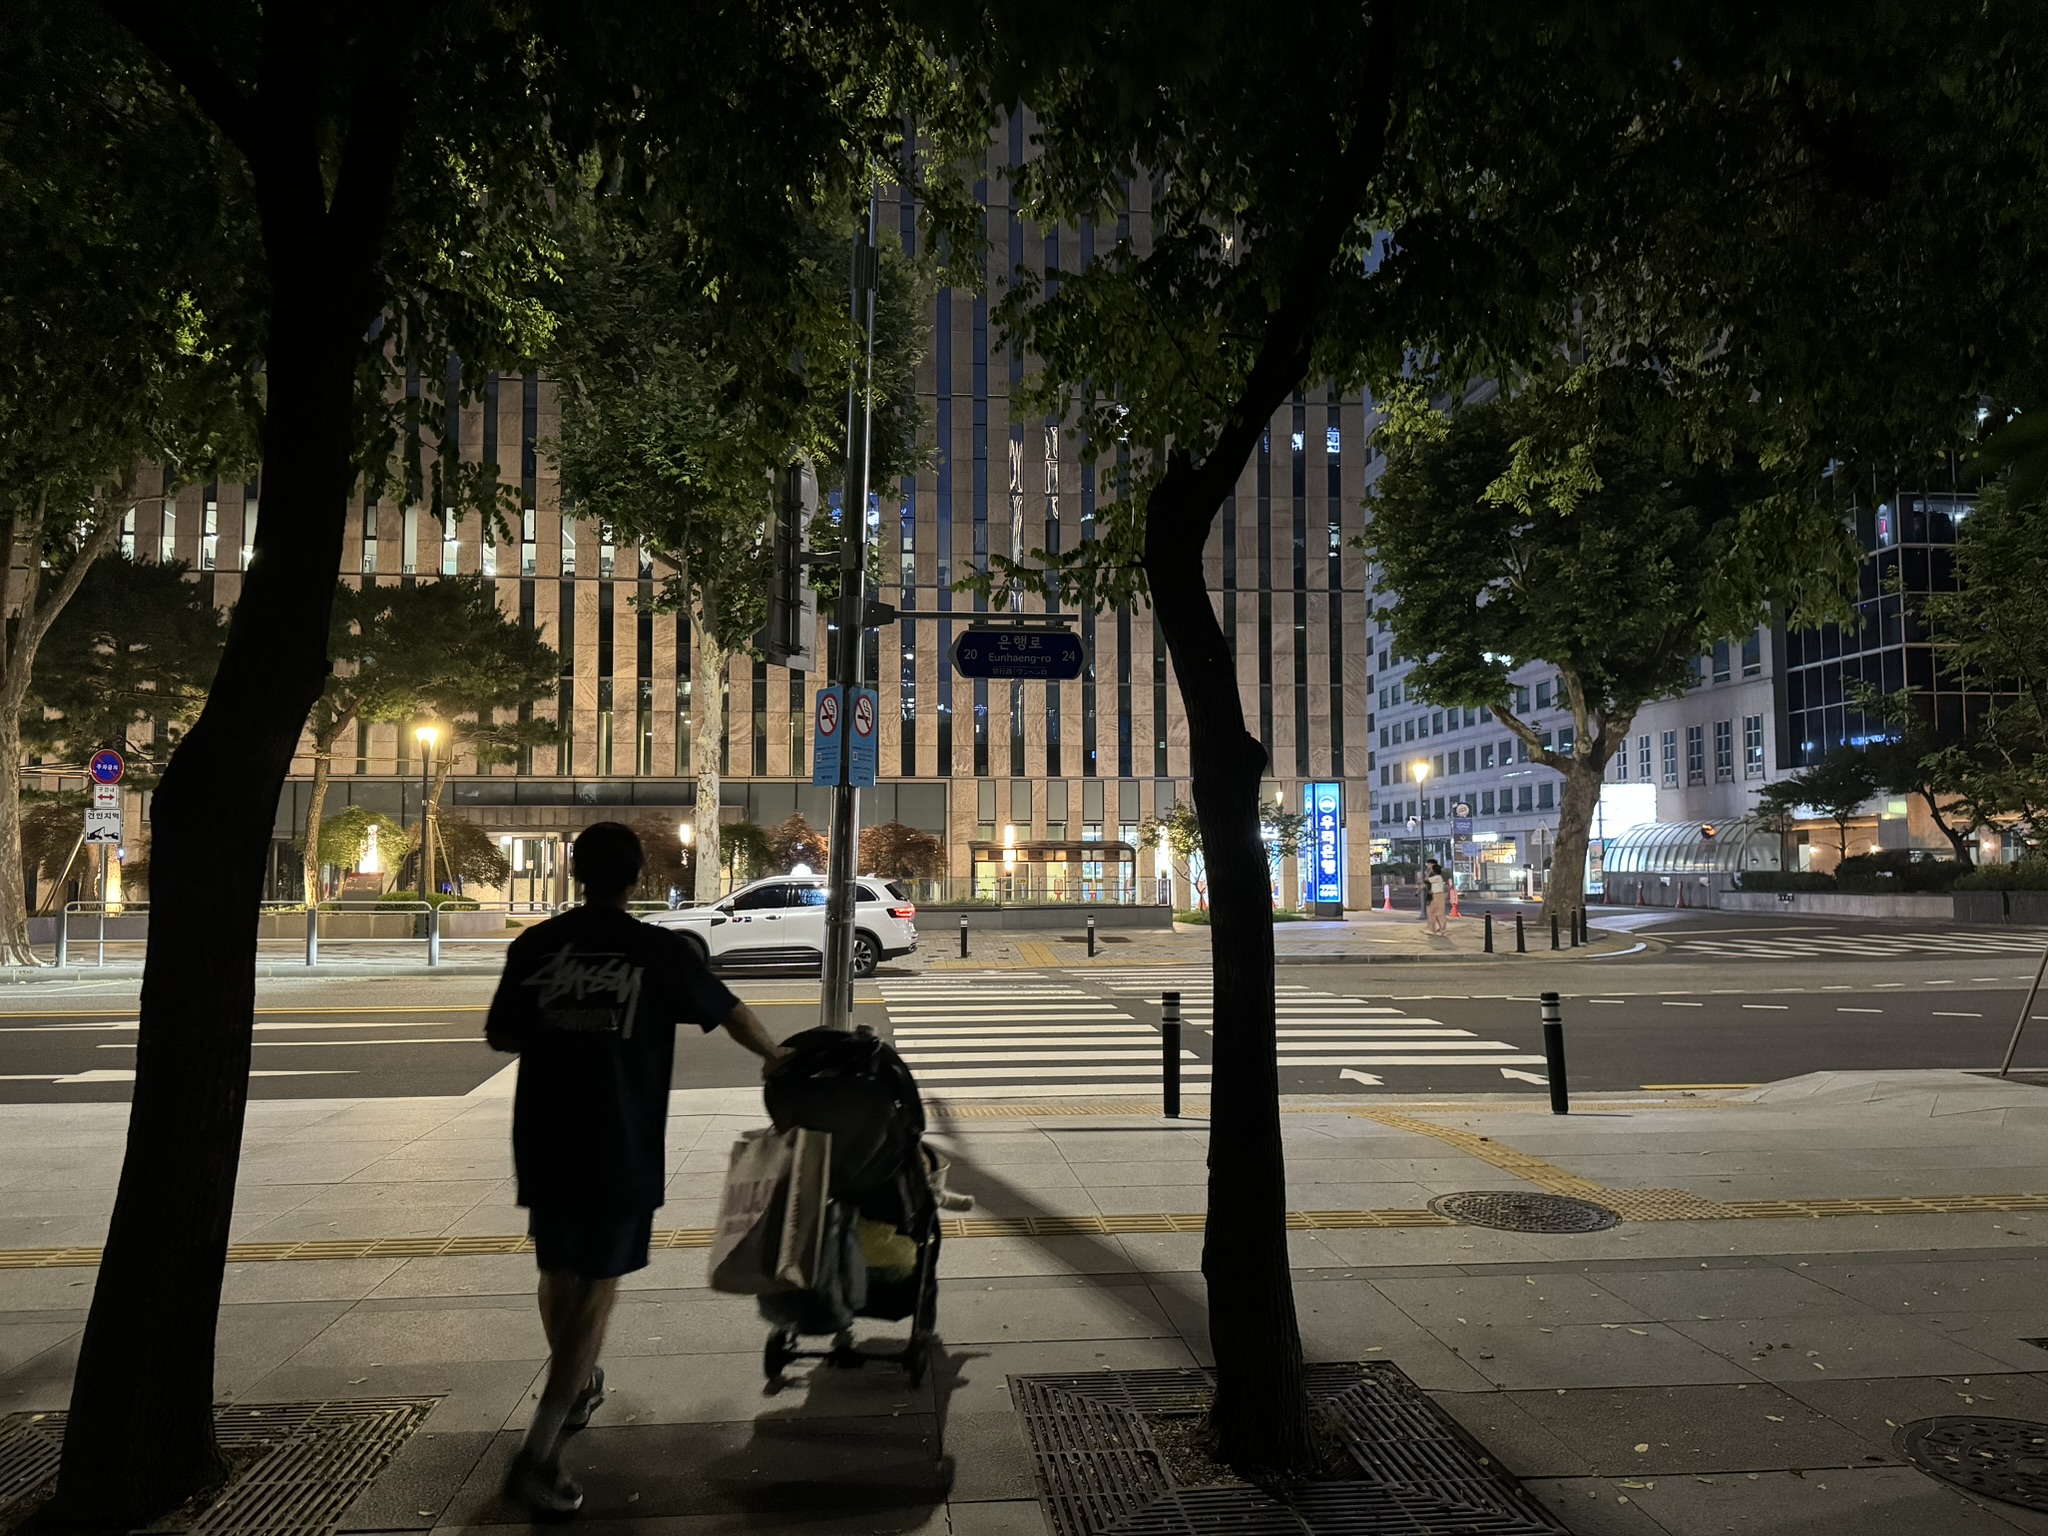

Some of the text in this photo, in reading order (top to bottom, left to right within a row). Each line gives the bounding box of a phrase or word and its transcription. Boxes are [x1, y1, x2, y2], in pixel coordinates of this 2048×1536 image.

[997, 635, 1043, 651] 은행로
[963, 649, 978, 660] 20
[988, 652, 1052, 664] Eunhaeng-ro
[1061, 651, 1076, 662] 24
[96, 763, 119, 771] 주차금지
[87, 812, 120, 820] 견인지역
